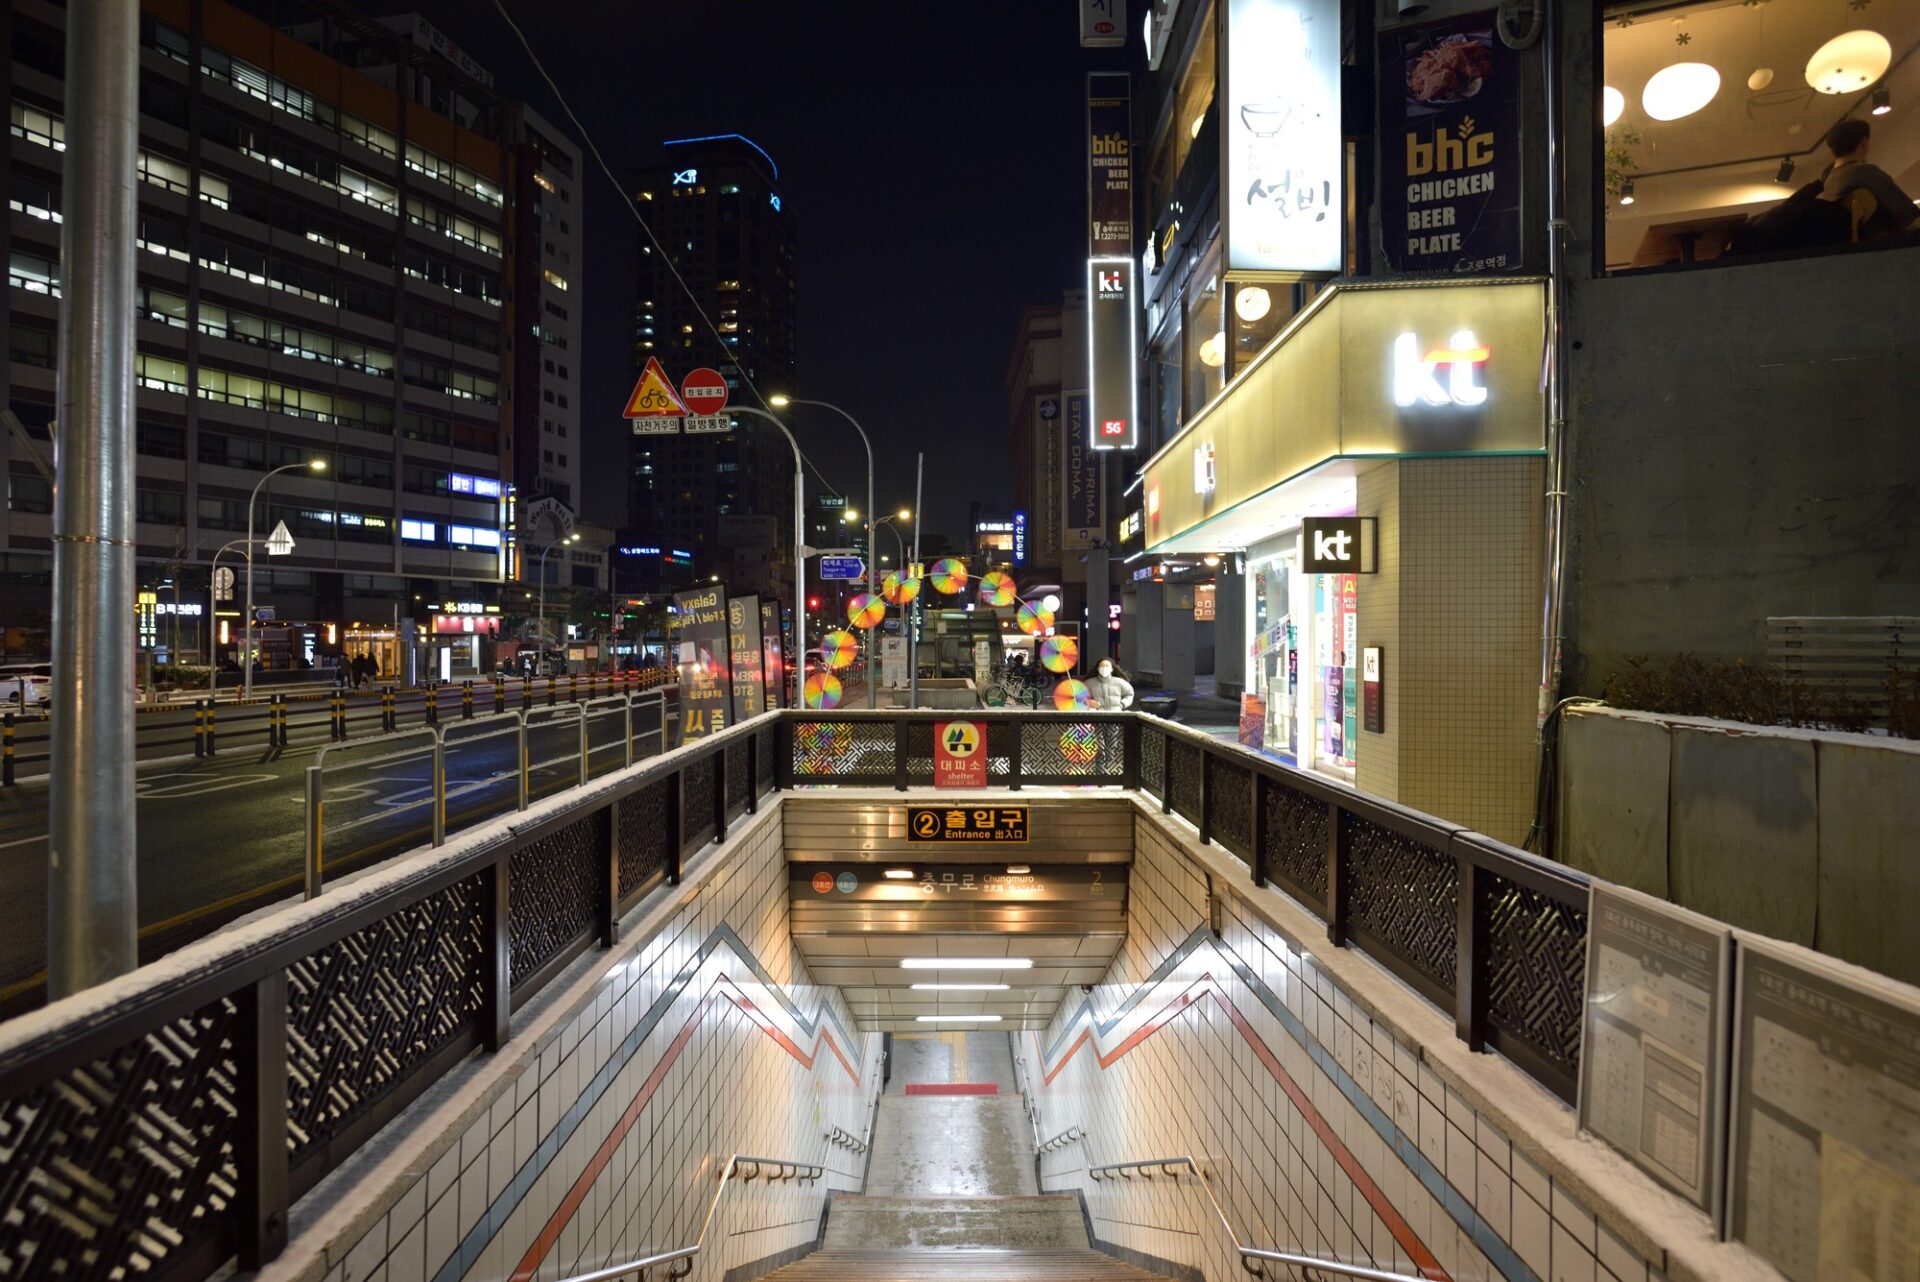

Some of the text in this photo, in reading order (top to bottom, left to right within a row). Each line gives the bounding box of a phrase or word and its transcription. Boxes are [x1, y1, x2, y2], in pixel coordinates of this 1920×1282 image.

[1092, 134, 1128, 154] bhc
[1406, 128, 1494, 177] bhc
[1092, 157, 1128, 167] CHICKEN
[1108, 169, 1128, 178] BEER
[1106, 181, 1128, 190] PLATE
[1407, 171, 1495, 203] CHICKEN
[1407, 206, 1456, 231] BEER
[1407, 232, 1462, 256] PLATE
[1099, 271, 1124, 292] kt
[1393, 330, 1490, 406] kt
[688, 388, 723, 397] 진입금지
[636, 420, 678, 432] 자전거주의
[687, 418, 728, 430] 일방통행
[1071, 401, 1082, 440] STAY
[1105, 422, 1122, 434] 5G
[1314, 530, 1352, 561] kt
[940, 760, 981, 771] 대피소
[947, 772, 975, 780] shelter
[945, 810, 1023, 829] 출입구
[945, 829, 1023, 840] Entrance 出入口
[919, 871, 979, 894] 충무로
[983, 874, 1035, 885] Chungmuro
[1092, 871, 1102, 887] 2
